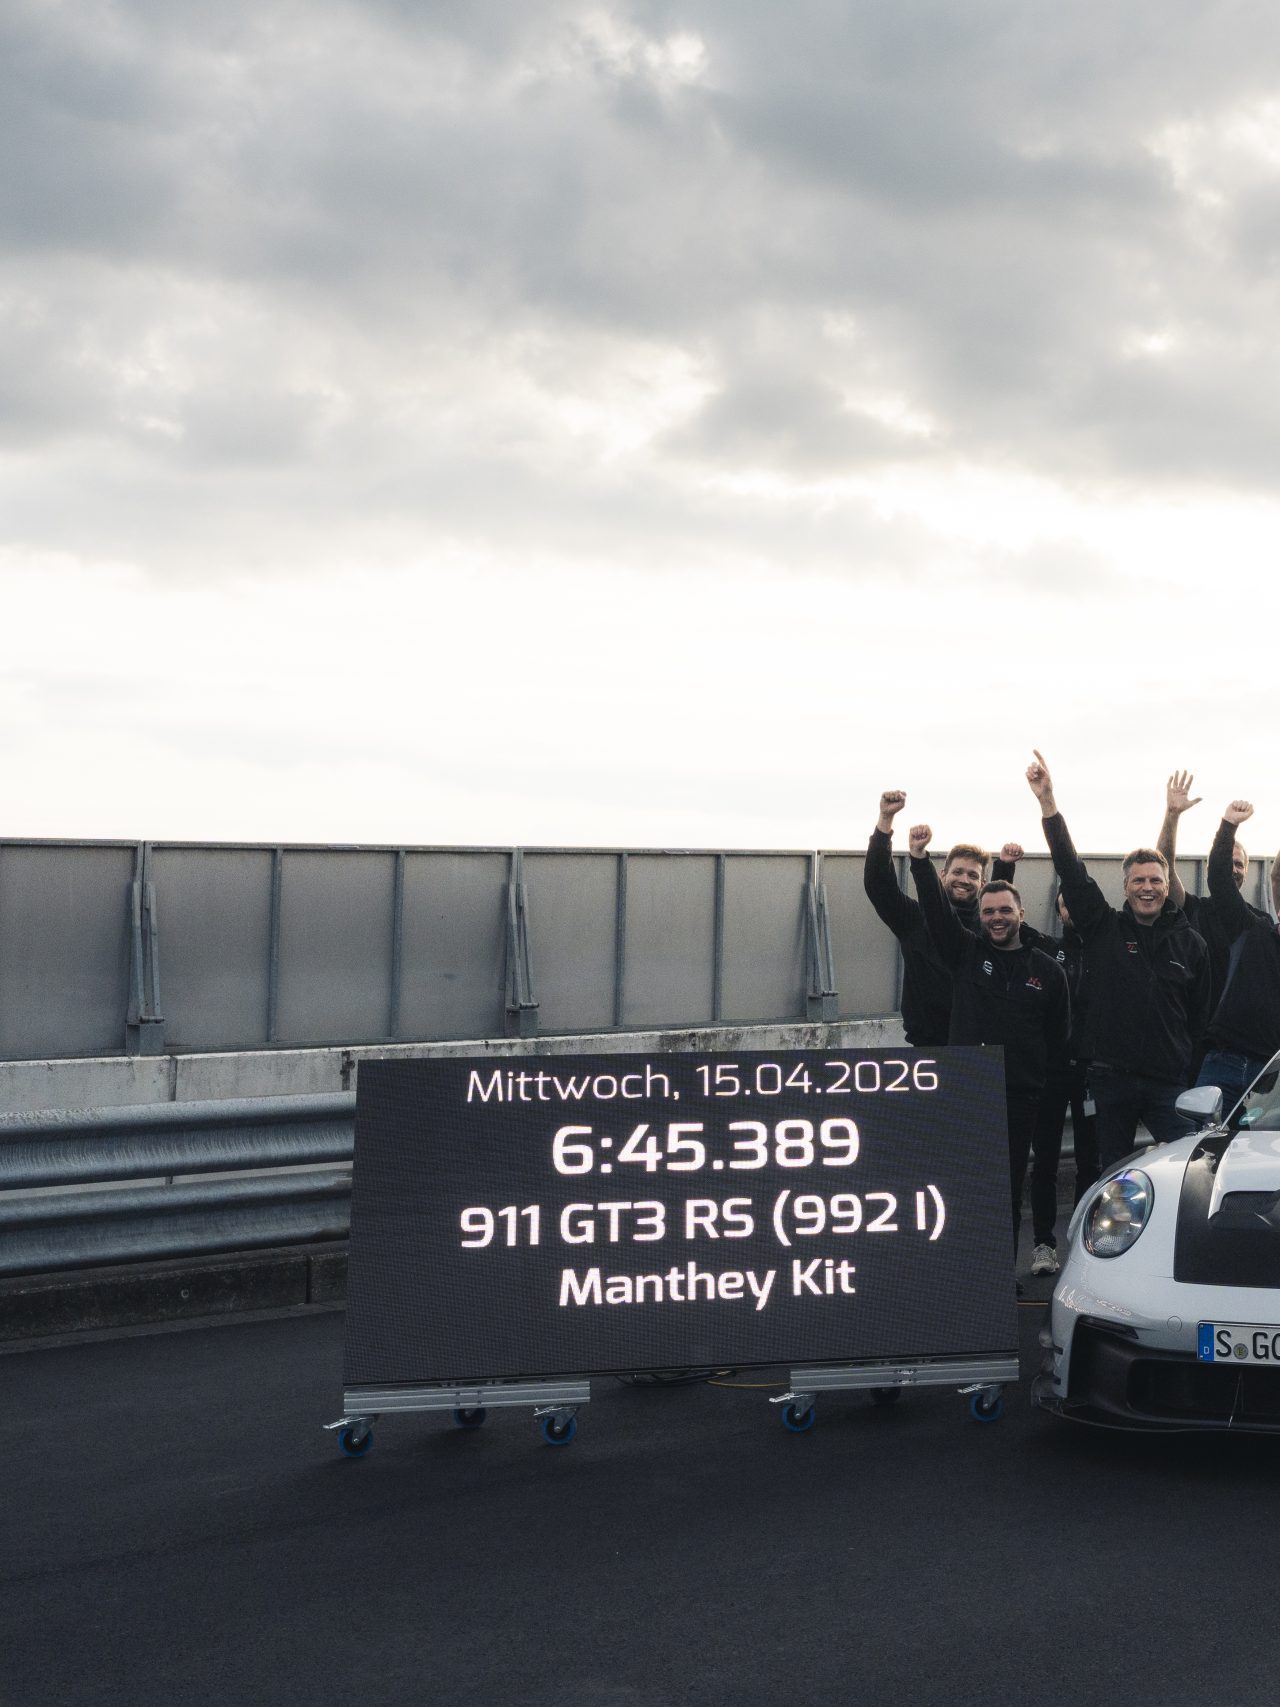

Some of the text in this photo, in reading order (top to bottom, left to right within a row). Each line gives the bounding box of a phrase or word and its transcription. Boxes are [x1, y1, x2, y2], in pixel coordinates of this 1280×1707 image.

[466, 1059, 939, 1103] Mittwoch, 15.04.2026
[552, 1117, 861, 1176] 6:45.389
[460, 1204, 540, 1249] 911
[559, 1200, 666, 1245] GT3
[685, 1197, 755, 1240] RS
[772, 1189, 899, 1246] (992
[558, 1258, 856, 1311] Manthey Kit
[1203, 1346, 1210, 1355] D
[1215, 1329, 1232, 1358] S
